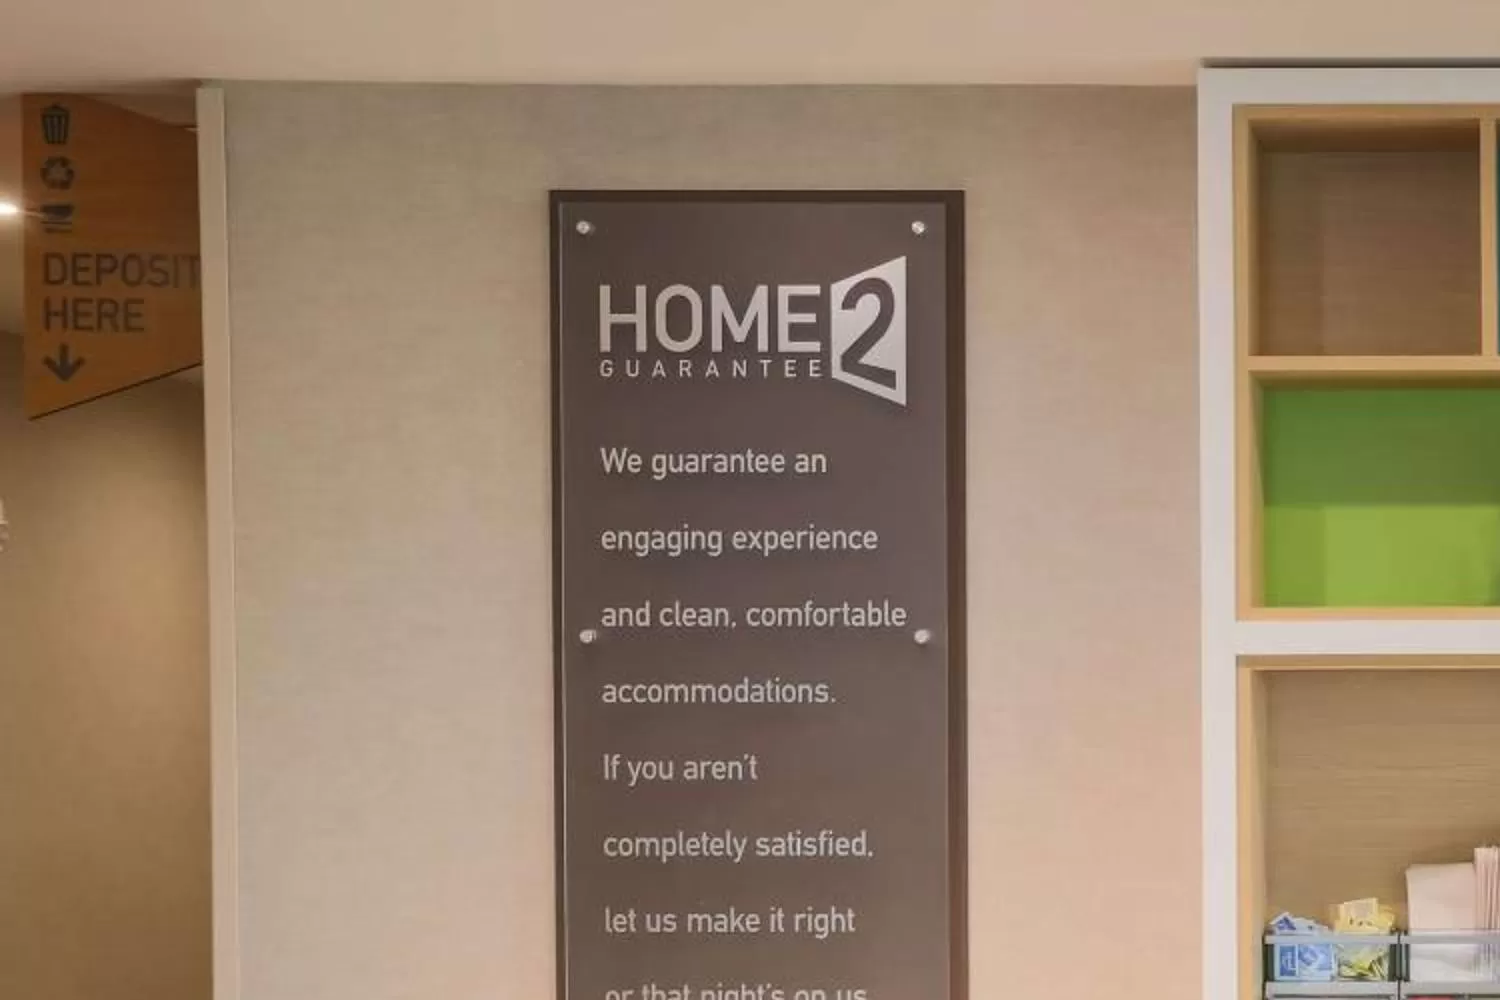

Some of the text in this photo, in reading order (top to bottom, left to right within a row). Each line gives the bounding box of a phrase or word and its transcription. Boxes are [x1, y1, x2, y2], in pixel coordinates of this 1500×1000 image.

[43, 252, 201, 289] DEPOSIT
[43, 296, 145, 332] HERE
[599, 276, 898, 392] HOME 2
[599, 359, 823, 378] GUARANTEE
[600, 447, 827, 481] We guarantee an
[601, 523, 879, 558] engaging experience
[601, 599, 907, 630] and clean, comfortable
[602, 676, 836, 704] accommodations.
[603, 753, 758, 787] If you aren't
[603, 829, 748, 864] completely
[604, 906, 856, 940] let us make it right
